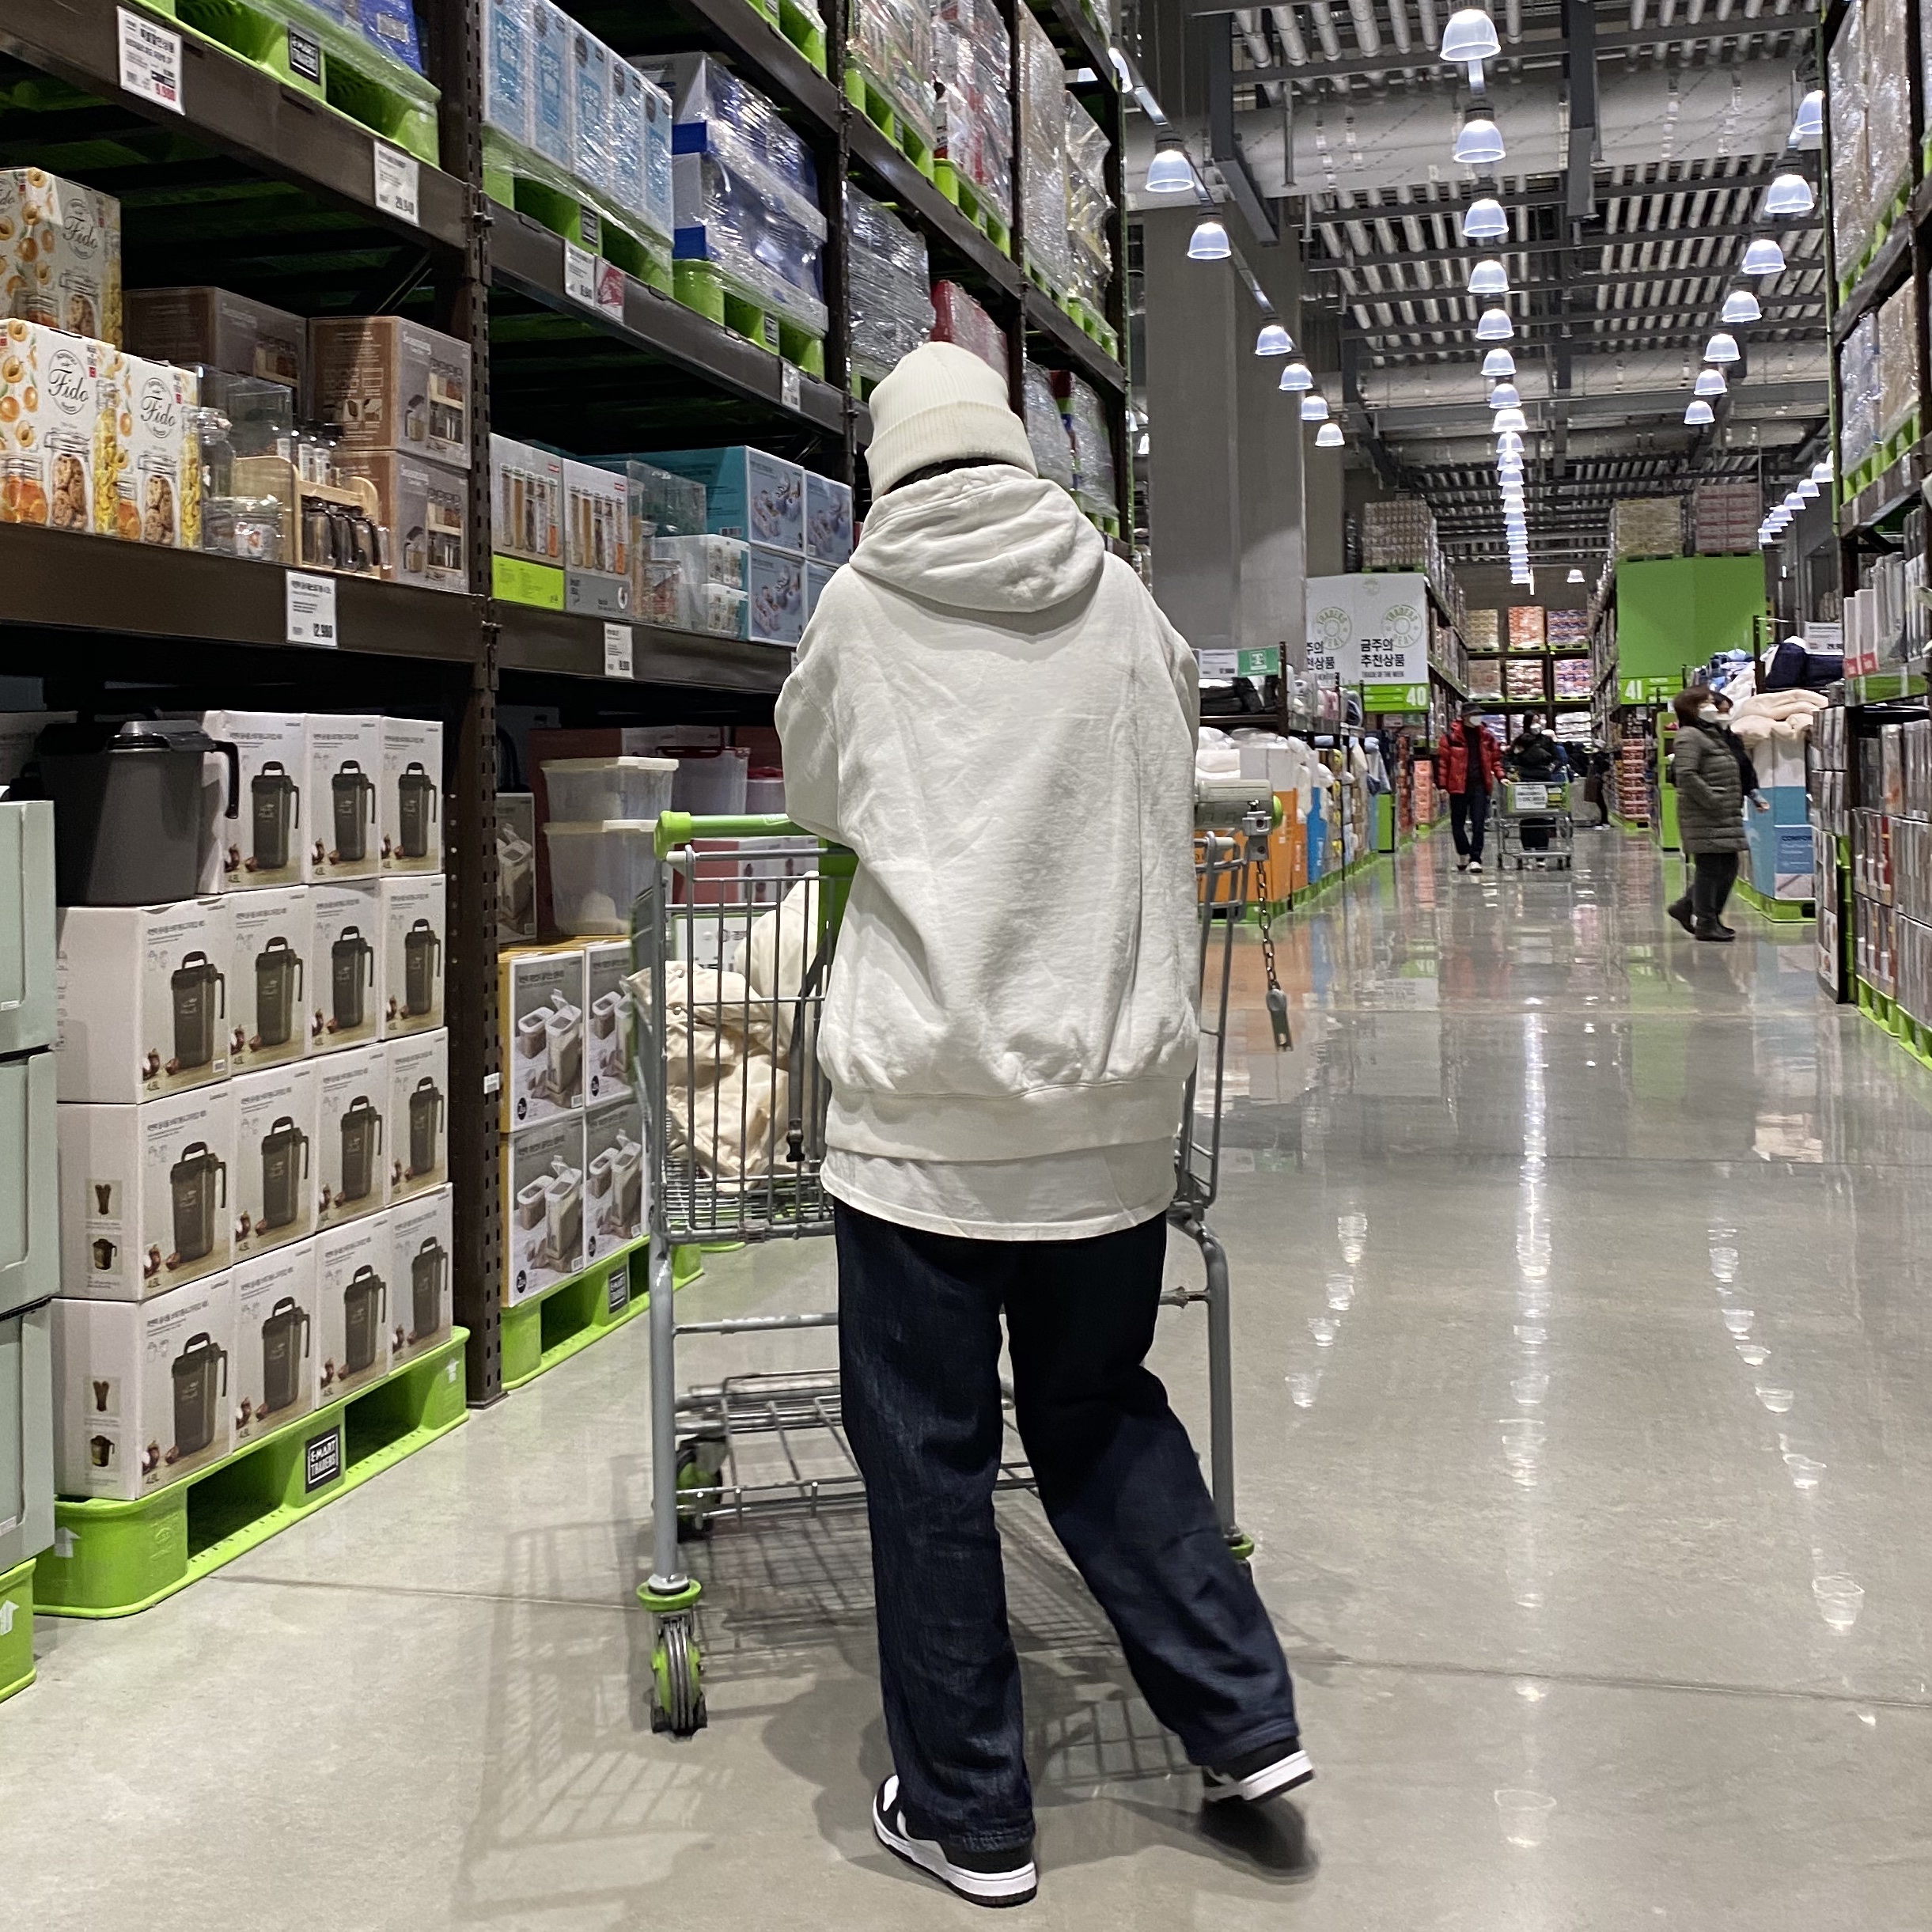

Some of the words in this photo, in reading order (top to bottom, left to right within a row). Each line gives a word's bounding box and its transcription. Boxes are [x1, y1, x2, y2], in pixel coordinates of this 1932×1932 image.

[63, 216, 98, 249] Fido
[48, 369, 89, 403] Fido
[140, 396, 176, 427] Fido
[1360, 638, 1393, 652] 금주의
[1361, 653, 1405, 668] 추천상품
[1406, 686, 1427, 707] 40
[1624, 680, 1642, 700] 41
